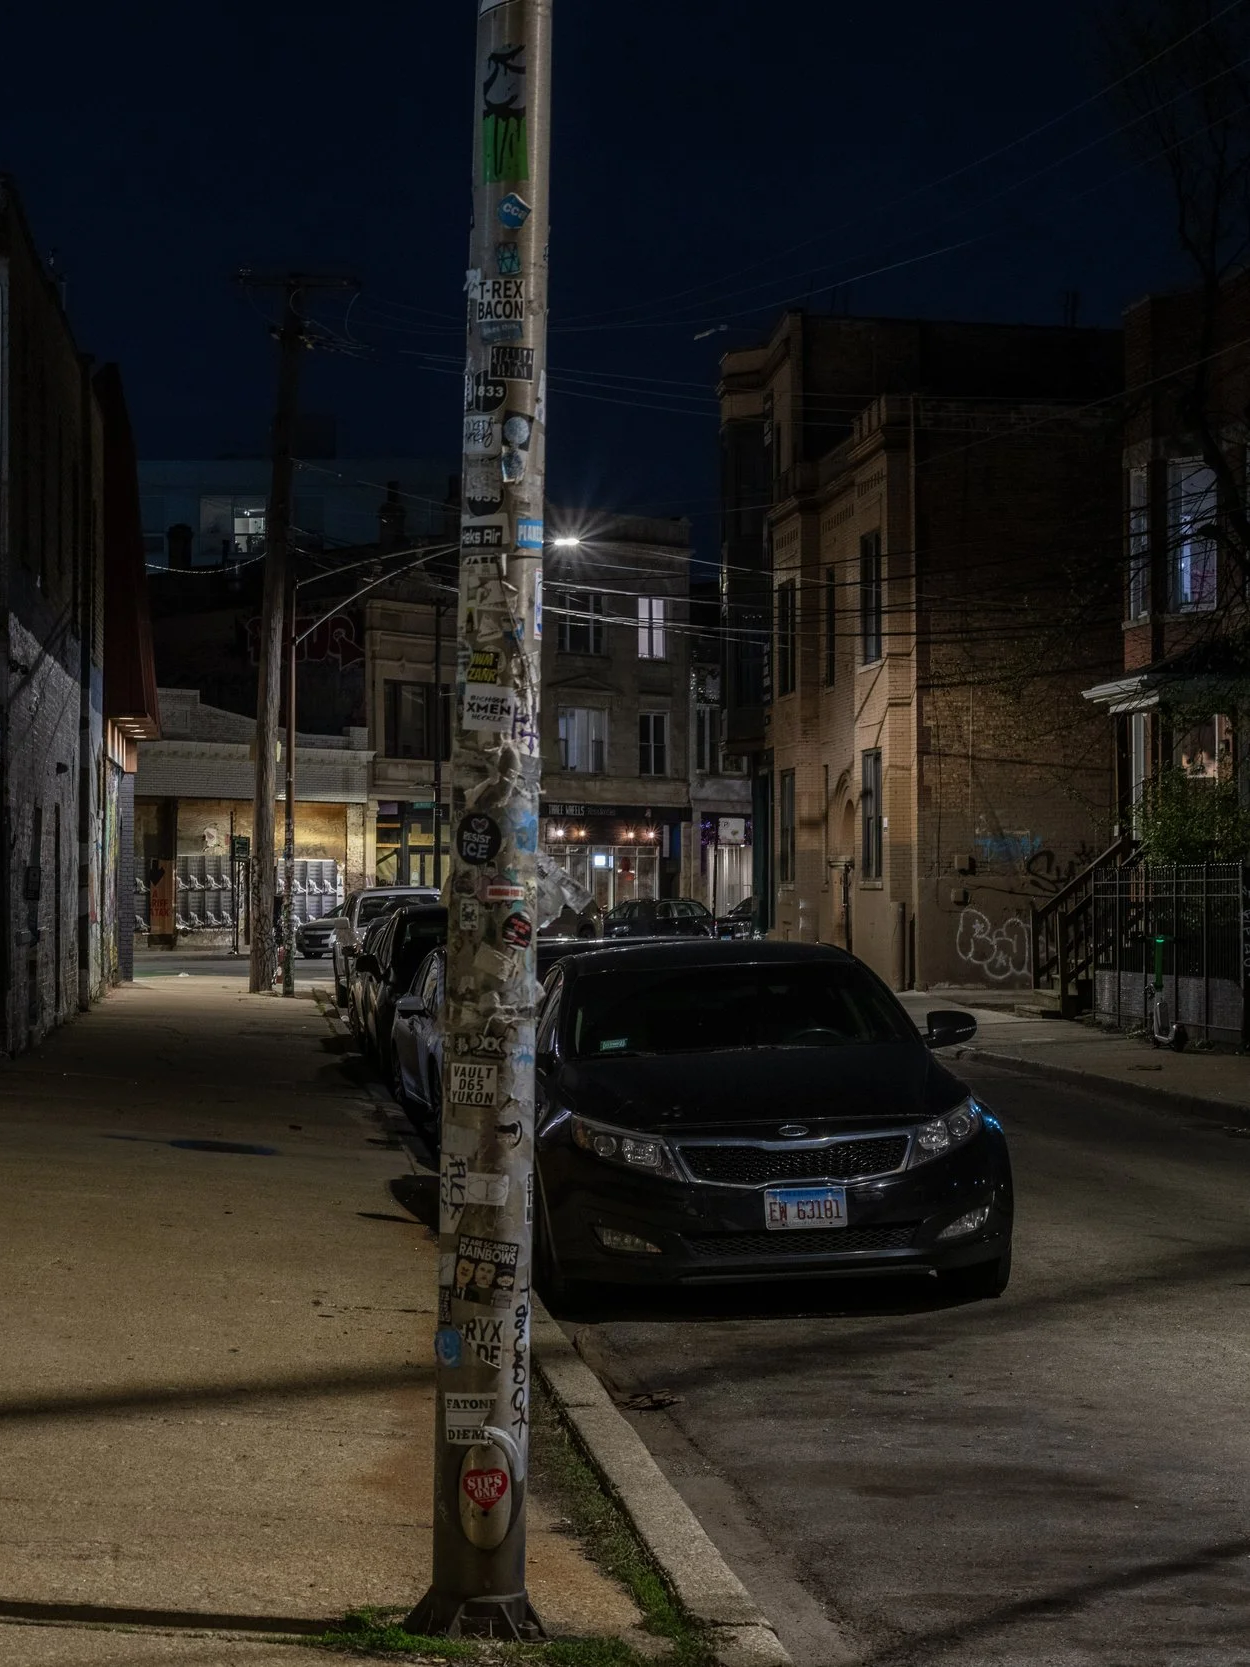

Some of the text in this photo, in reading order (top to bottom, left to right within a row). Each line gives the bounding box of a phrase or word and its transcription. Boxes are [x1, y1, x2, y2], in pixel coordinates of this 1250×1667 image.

[479, 281, 523, 299] T-REX
[478, 301, 523, 320] BACON
[483, 528, 501, 544] Air
[466, 702, 511, 716] XMEN
[463, 832, 491, 843] RESIST
[462, 842, 489, 859] ICE
[454, 1065, 493, 1079] VAULT
[459, 1079, 483, 1091] D65
[452, 1091, 493, 1104] YUKON
[470, 1239, 482, 1247] ARE
[483, 1240, 509, 1251] SCARED
[510, 1244, 518, 1252] OF
[458, 1244, 517, 1265] RAINBOWS
[467, 1475, 502, 1491] SIPS
[474, 1488, 498, 1499] ONE
